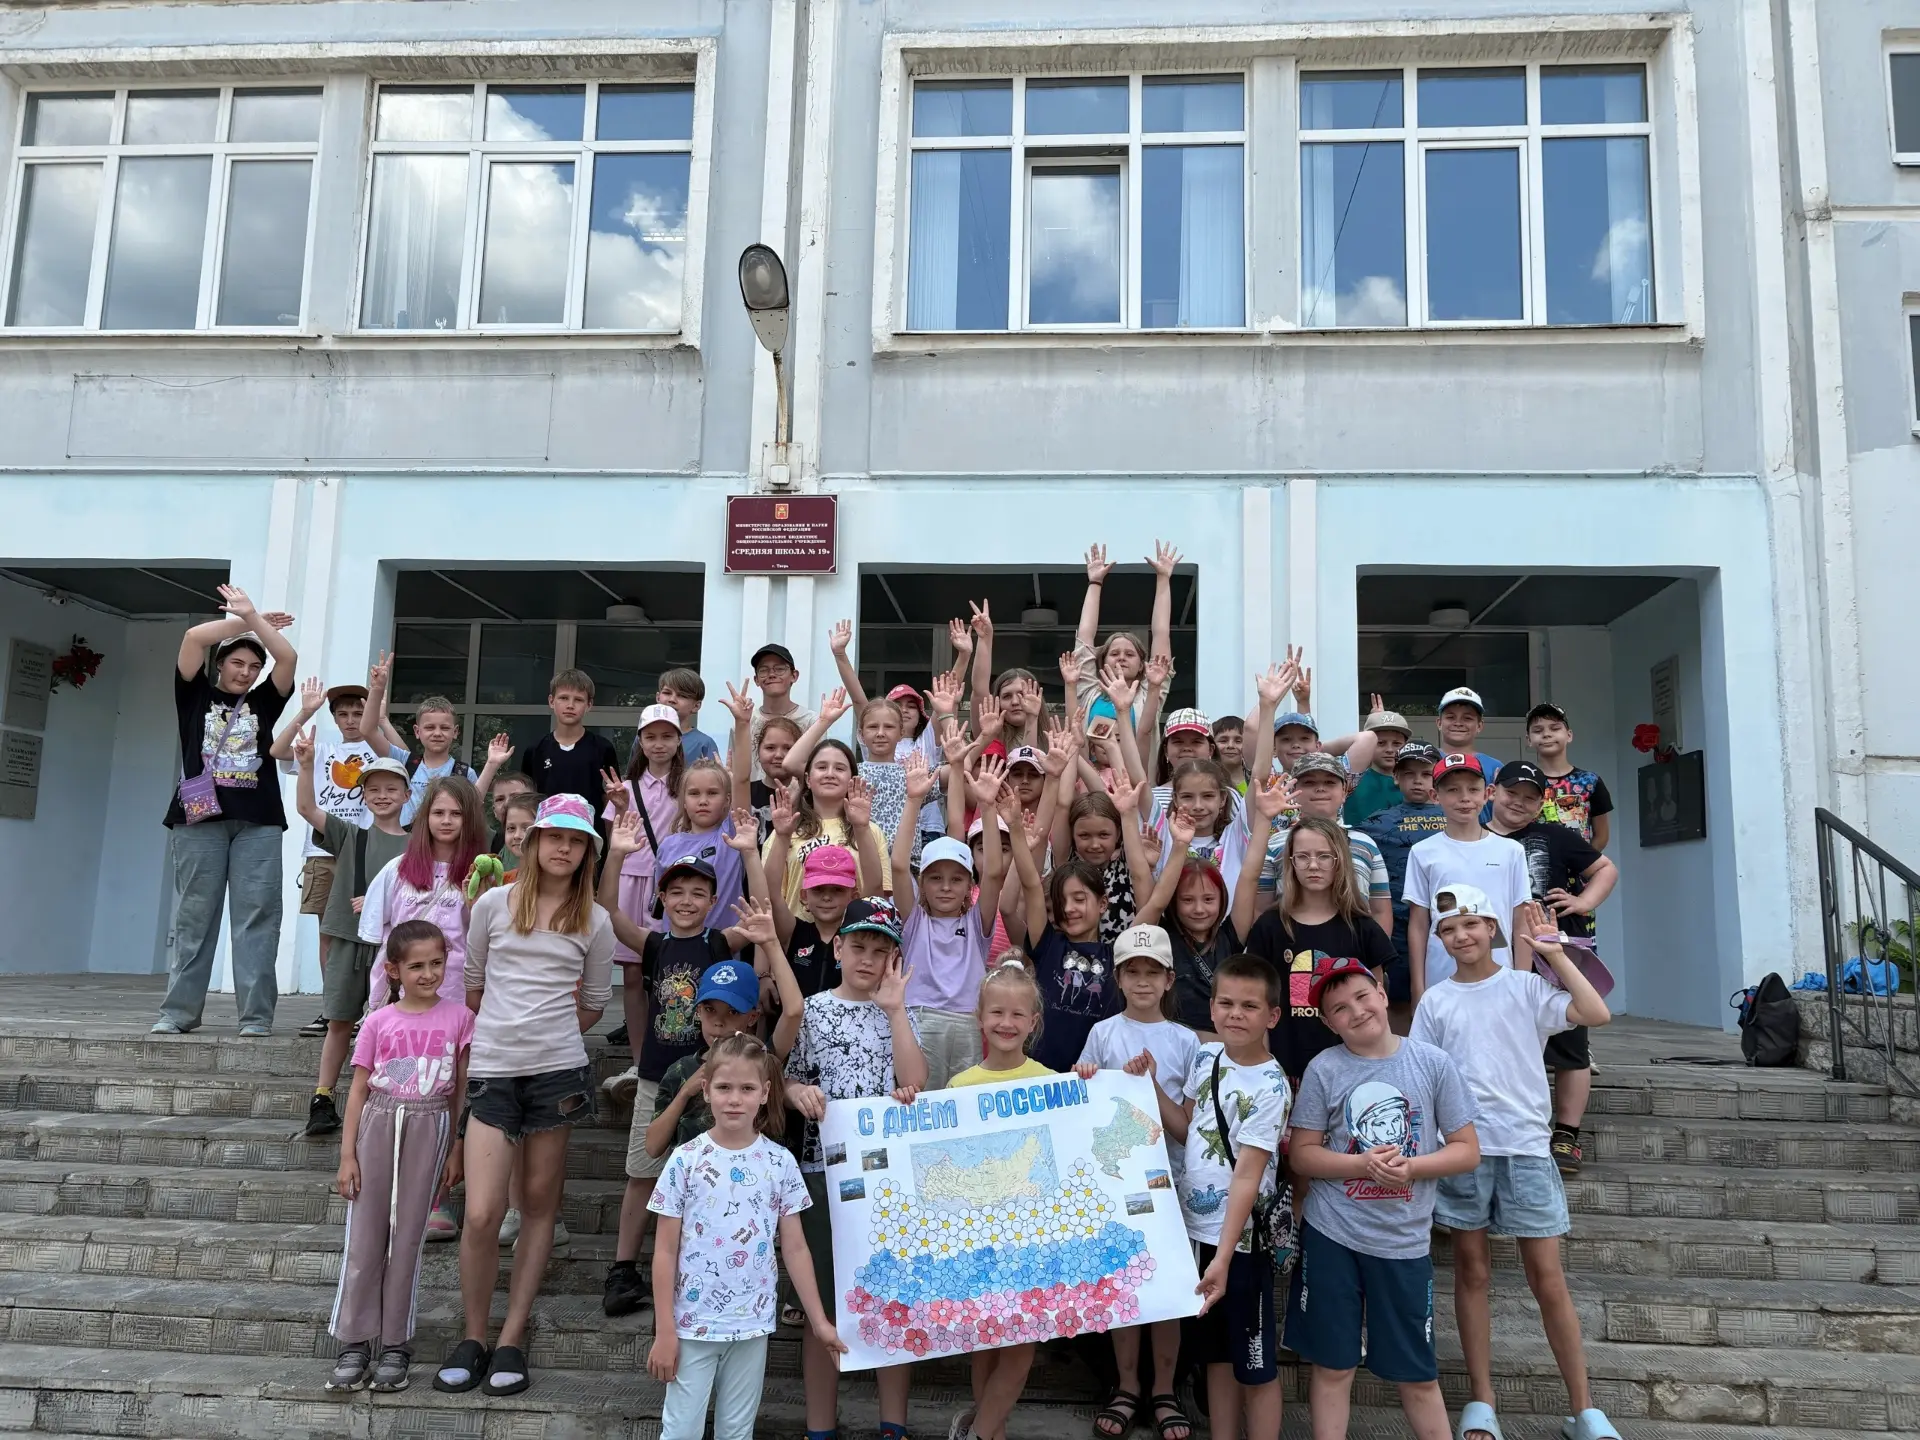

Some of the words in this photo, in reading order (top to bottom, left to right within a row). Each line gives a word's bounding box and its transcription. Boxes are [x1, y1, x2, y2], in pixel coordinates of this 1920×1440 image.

[318, 785, 346, 806] Stay
[1133, 931, 1152, 948] R
[380, 1029, 446, 1062] LIVE
[399, 1084, 418, 1094] AND
[857, 1107, 875, 1136] С
[883, 1097, 959, 1139] ДНЁМ
[978, 1078, 1090, 1121] РОССИИ!
[1300, 1285, 1309, 1313] GOOD
